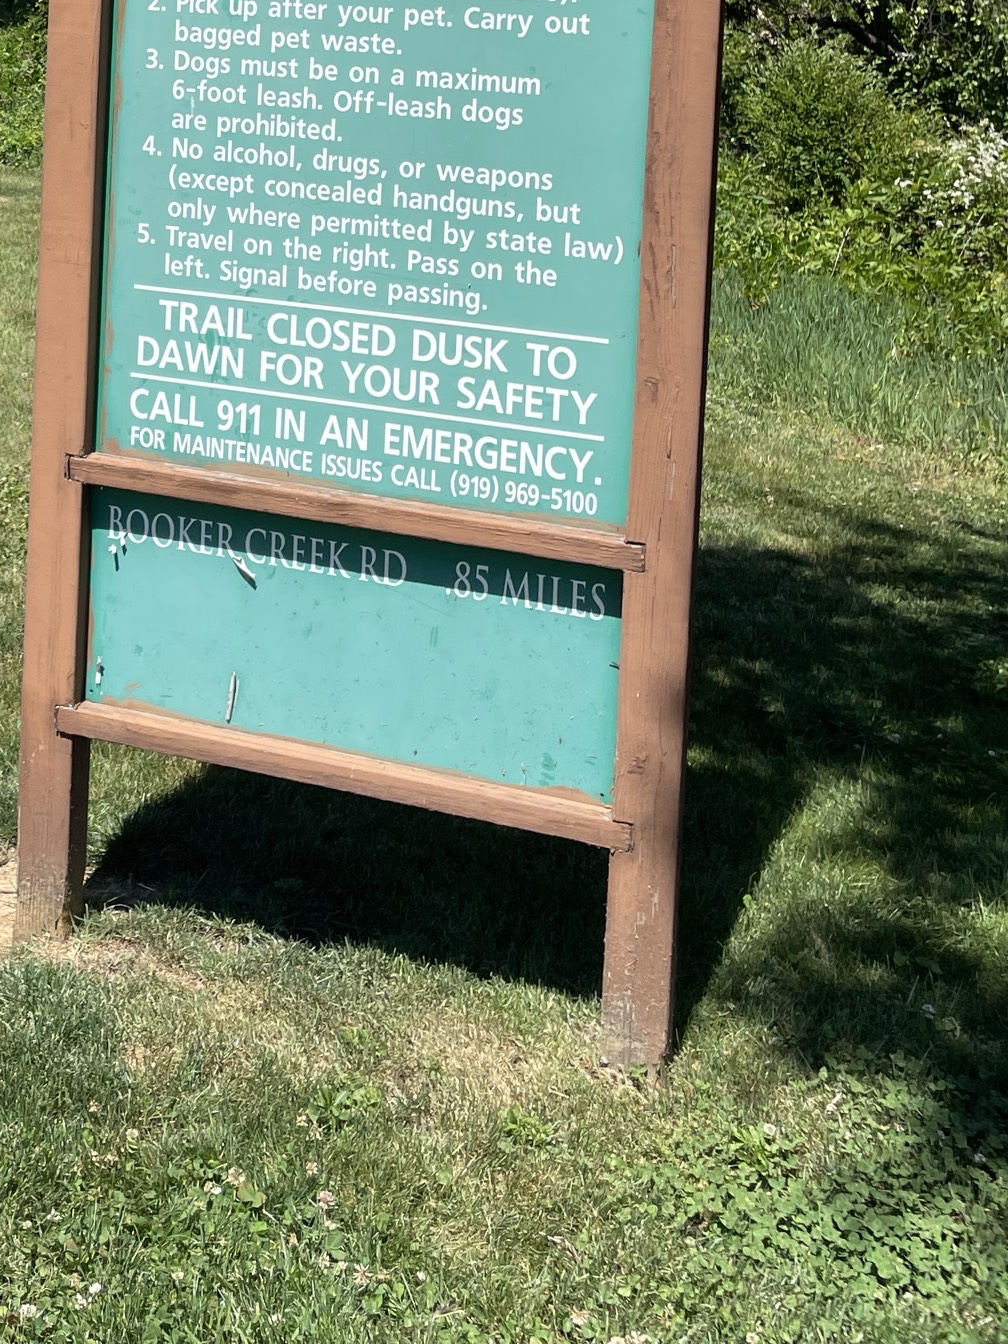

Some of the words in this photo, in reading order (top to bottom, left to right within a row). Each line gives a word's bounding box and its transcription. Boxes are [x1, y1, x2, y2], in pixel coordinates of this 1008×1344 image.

[175, 19, 261, 50] bagged
[271, 29, 310, 53] pet
[321, 33, 402, 55] waste.
[229, 0, 258, 22] up
[338, 5, 394, 27] your
[404, 6, 452, 31] pet.
[464, 7, 533, 38] Carry
[545, 14, 590, 35] out
[146, 48, 164, 69] 3.
[174, 50, 230, 79] Dogs
[241, 58, 298, 78] must
[309, 57, 338, 81] be
[349, 66, 379, 84] on
[390, 68, 404, 86] a
[416, 67, 540, 95] maximum
[171, 109, 207, 131] are
[217, 112, 342, 142] prohibited.
[172, 79, 247, 108] 6-foot
[257, 83, 323, 110] leash.
[334, 90, 451, 120] Off-leash
[462, 98, 523, 130] dogs
[142, 135, 162, 156] 4.
[172, 137, 203, 159] No
[213, 140, 302, 171] alcohol,
[313, 148, 387, 180] drugs,
[399, 161, 425, 179] or
[436, 164, 553, 192] weapons
[169, 164, 254, 198] (except
[264, 179, 382, 206] concealed
[393, 184, 523, 222] handguns,
[536, 197, 581, 224] but
[138, 223, 155, 244] 5.
[165, 225, 233, 252] Travel
[243, 238, 272, 256] on
[283, 236, 322, 261] the
[333, 241, 396, 271] right.
[408, 249, 459, 276] Pass
[471, 261, 502, 281] on
[514, 260, 557, 287] the
[168, 197, 216, 226] only
[226, 202, 300, 229] where
[311, 214, 432, 242] permitted
[443, 220, 475, 252] by
[486, 229, 552, 254] state
[565, 232, 623, 264] law)
[165, 252, 210, 279] left.
[220, 260, 287, 289] Signal
[298, 266, 377, 297] before
[388, 282, 487, 315] passing.
[159, 299, 253, 340] TRAIL
[267, 312, 396, 356] CLOSED
[412, 329, 508, 372] DUSK
[526, 342, 577, 380] TO
[137, 335, 244, 379] DAWN
[260, 351, 324, 389] FOR
[341, 361, 440, 405] YOUR
[456, 376, 598, 425] SAFETY
[130, 387, 204, 427] CALL
[217, 399, 261, 435] 911
[275, 407, 306, 442] IN
[319, 415, 368, 451] AN
[384, 422, 602, 486] EMERGENCY.
[130, 425, 165, 450] FOR
[173, 432, 313, 472] MAINTENANCE
[321, 453, 383, 482] ISSUES
[391, 464, 441, 492] CALL
[450, 470, 499, 503] (919)
[505, 480, 598, 515] 969-5100
[108, 504, 233, 557] BOOKER
[243, 527, 350, 579] CREEK
[358, 545, 407, 587] RD
[445, 560, 489, 602] .85
[500, 568, 607, 621] MILES
